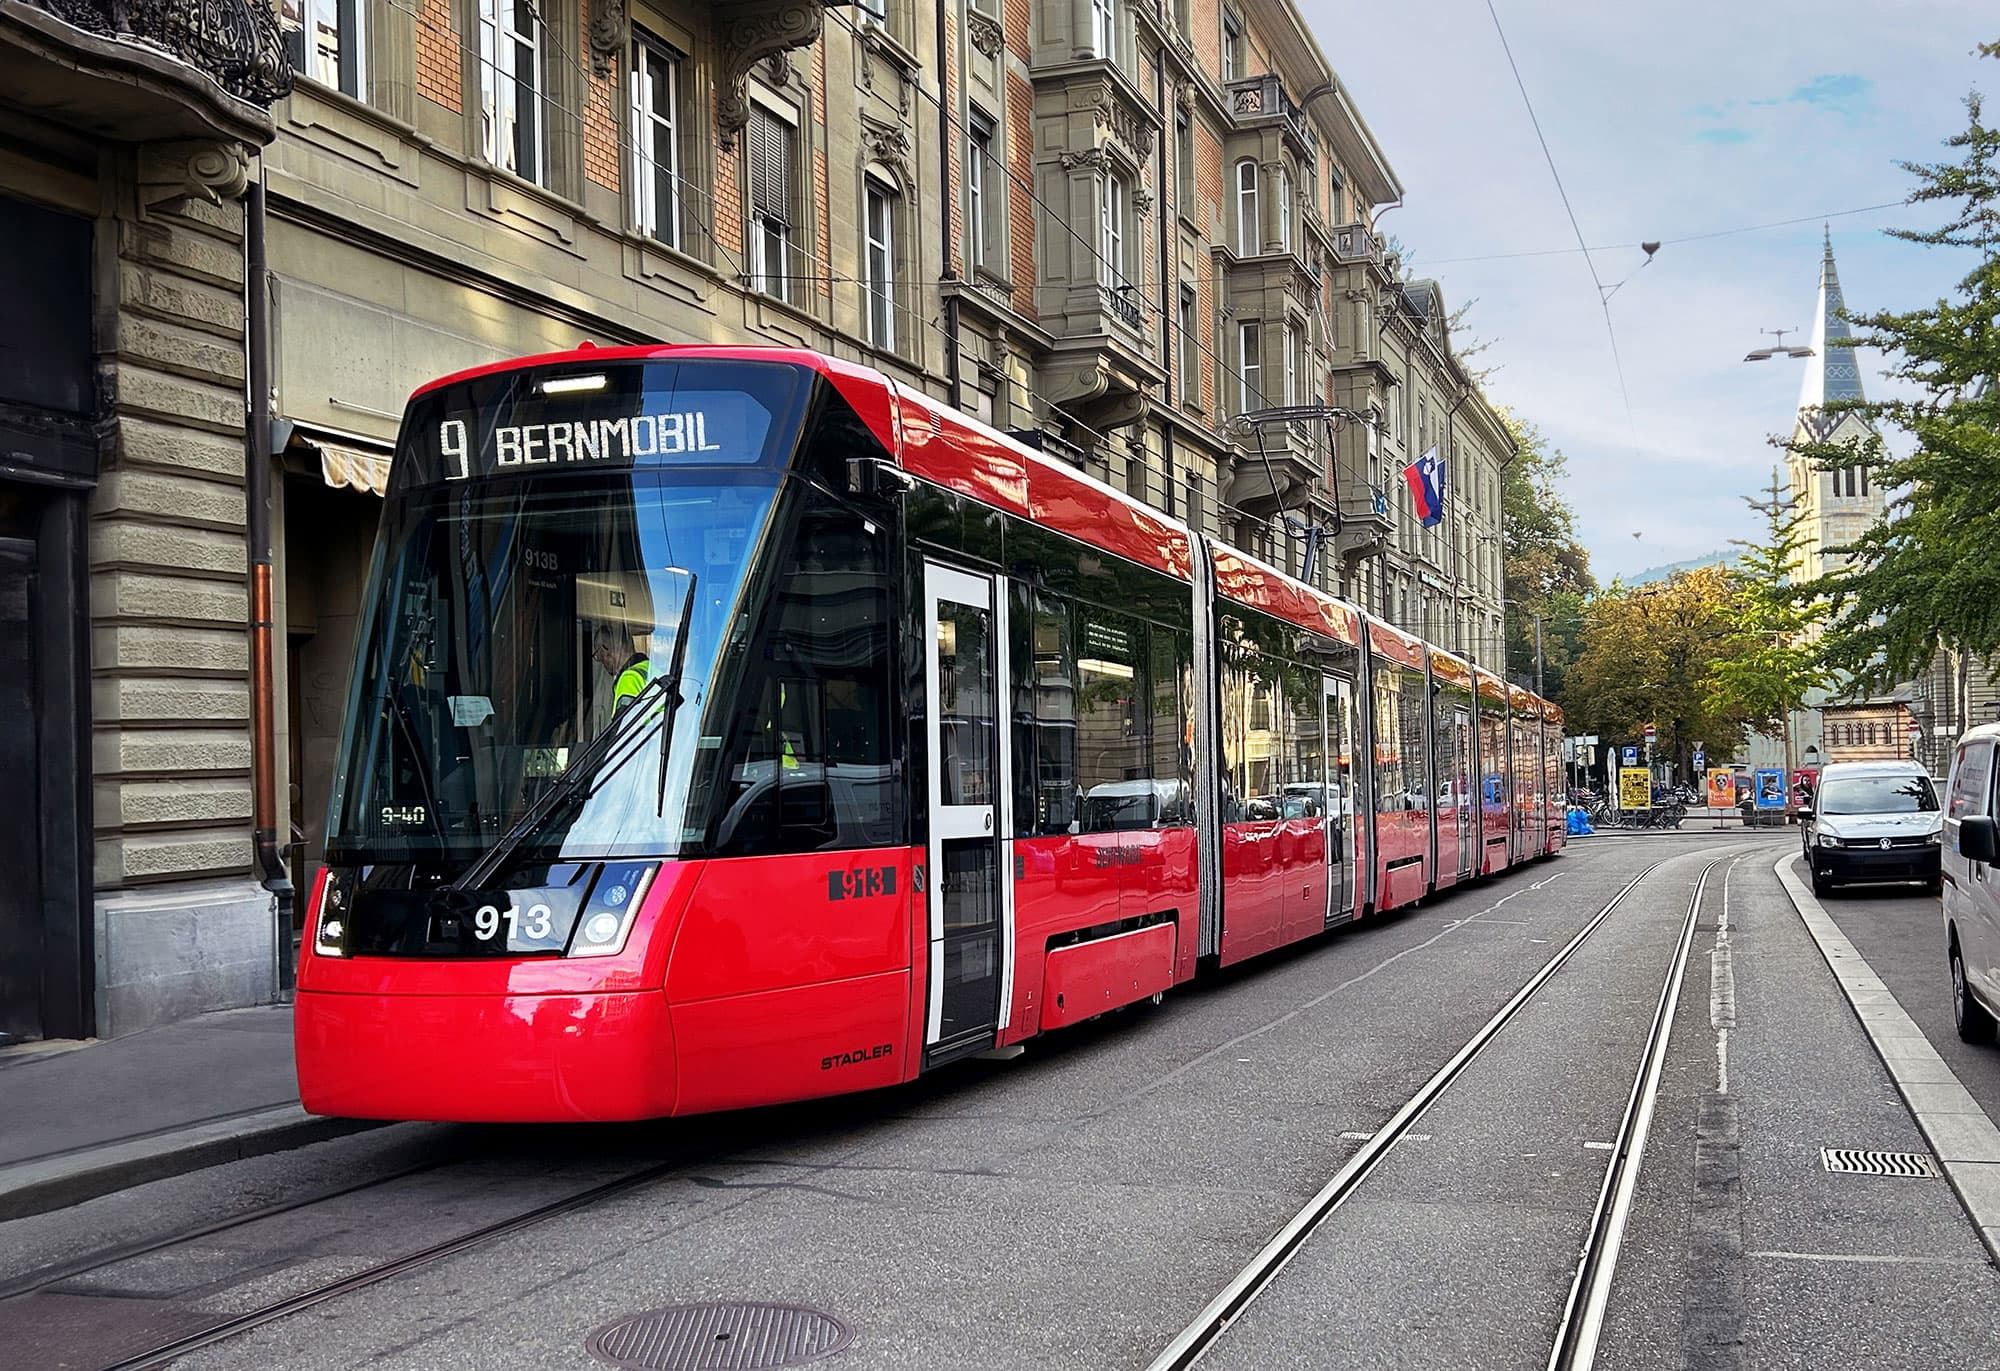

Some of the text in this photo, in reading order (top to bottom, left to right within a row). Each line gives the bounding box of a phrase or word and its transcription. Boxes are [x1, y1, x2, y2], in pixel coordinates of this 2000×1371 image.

[440, 411, 721, 481] 9 BERNMOBIL
[525, 547, 559, 571] 913B
[842, 866, 884, 898] 913
[474, 903, 552, 941] 913
[820, 1043, 893, 1070] STADLER
